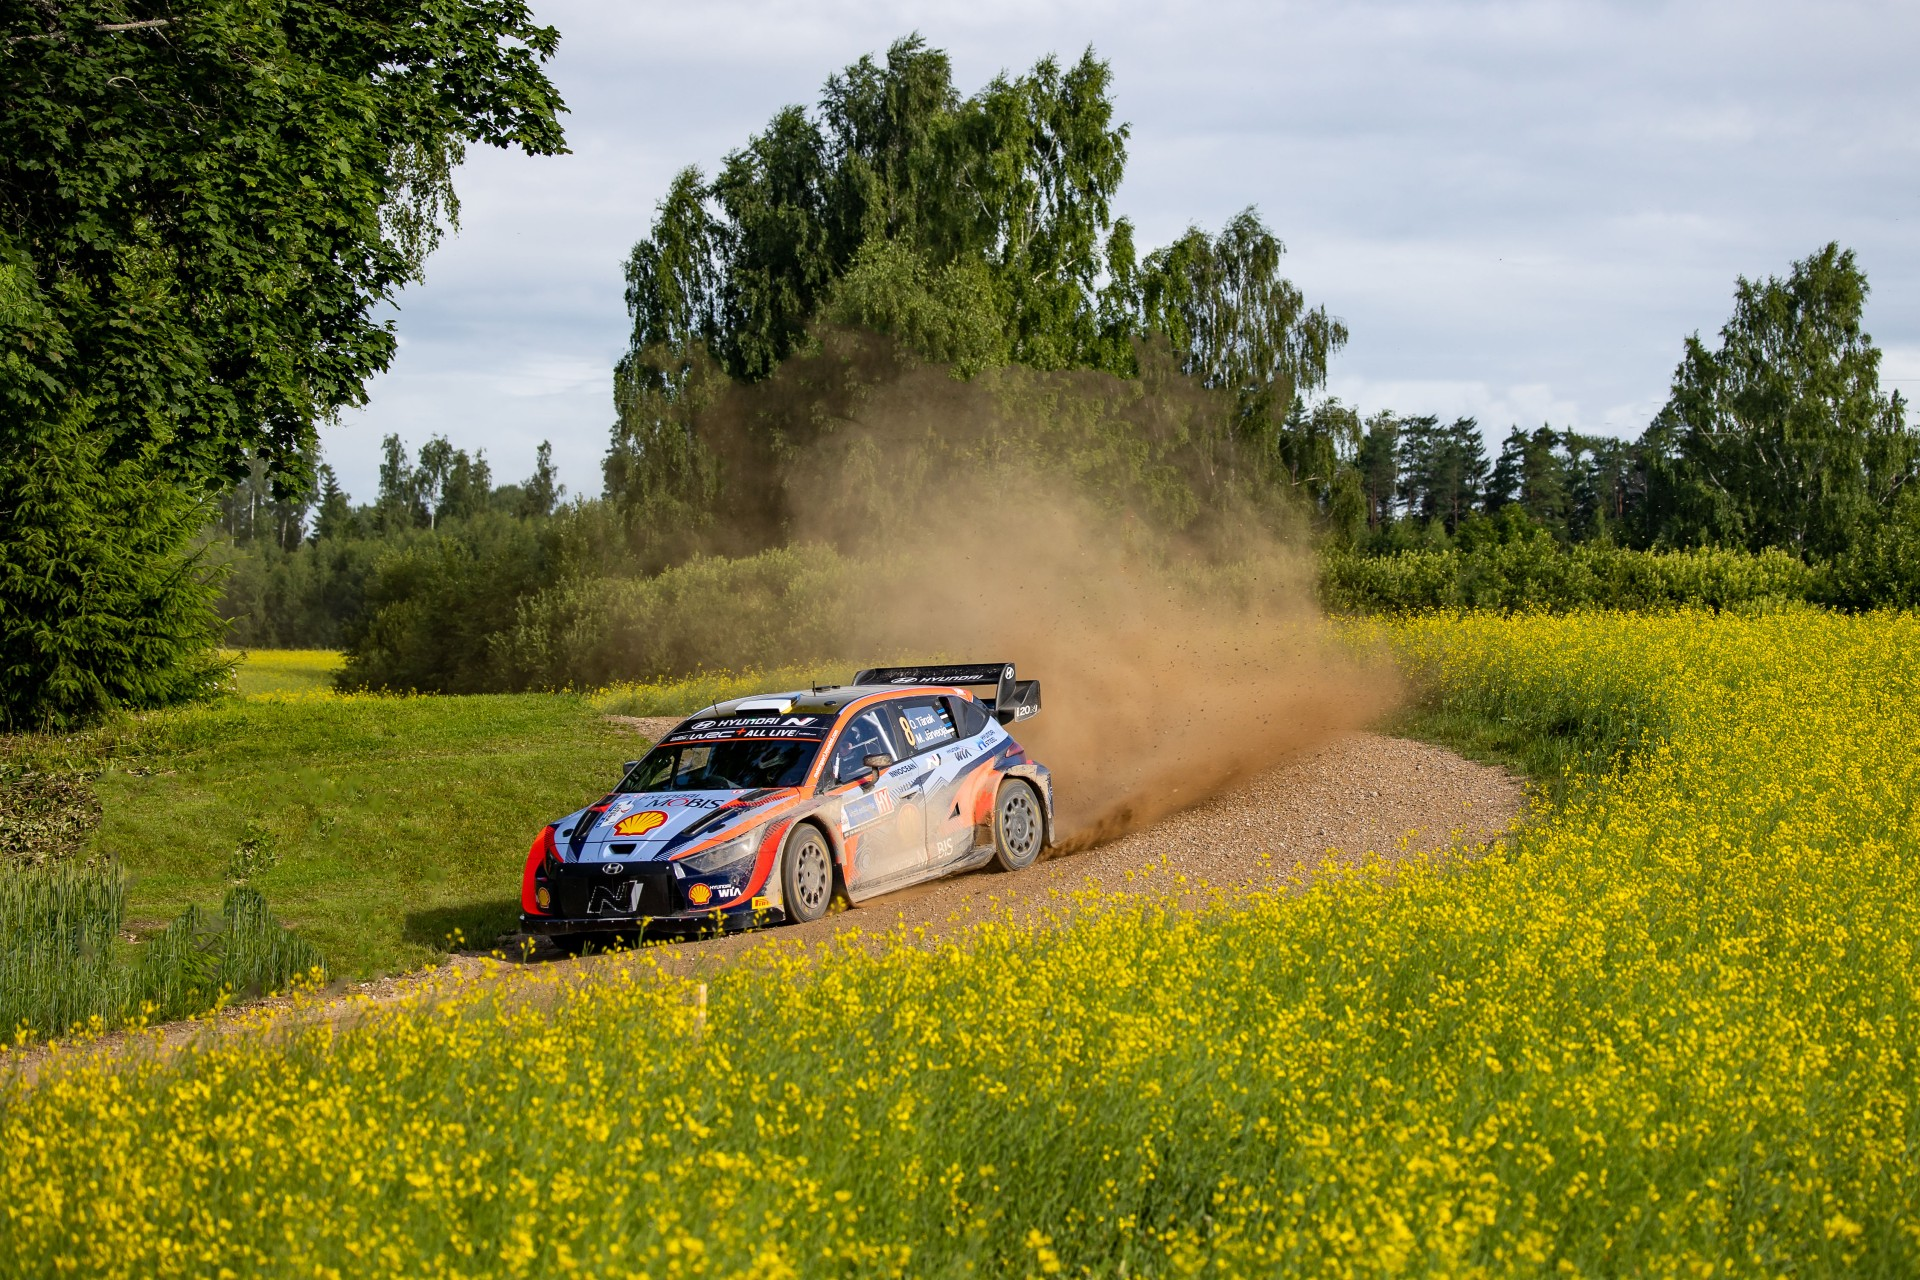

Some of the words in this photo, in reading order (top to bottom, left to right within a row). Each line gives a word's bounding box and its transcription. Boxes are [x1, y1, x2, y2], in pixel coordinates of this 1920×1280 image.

[919, 674, 984, 684] HYUNDAI
[717, 717, 781, 727] HYUNDAI
[744, 729, 769, 738] ALL
[769, 729, 797, 737] LIVE
[899, 716, 916, 747] 8
[888, 763, 917, 778] INNOCEAN
[645, 799, 724, 809] MOBIS
[718, 887, 743, 898] WIA
